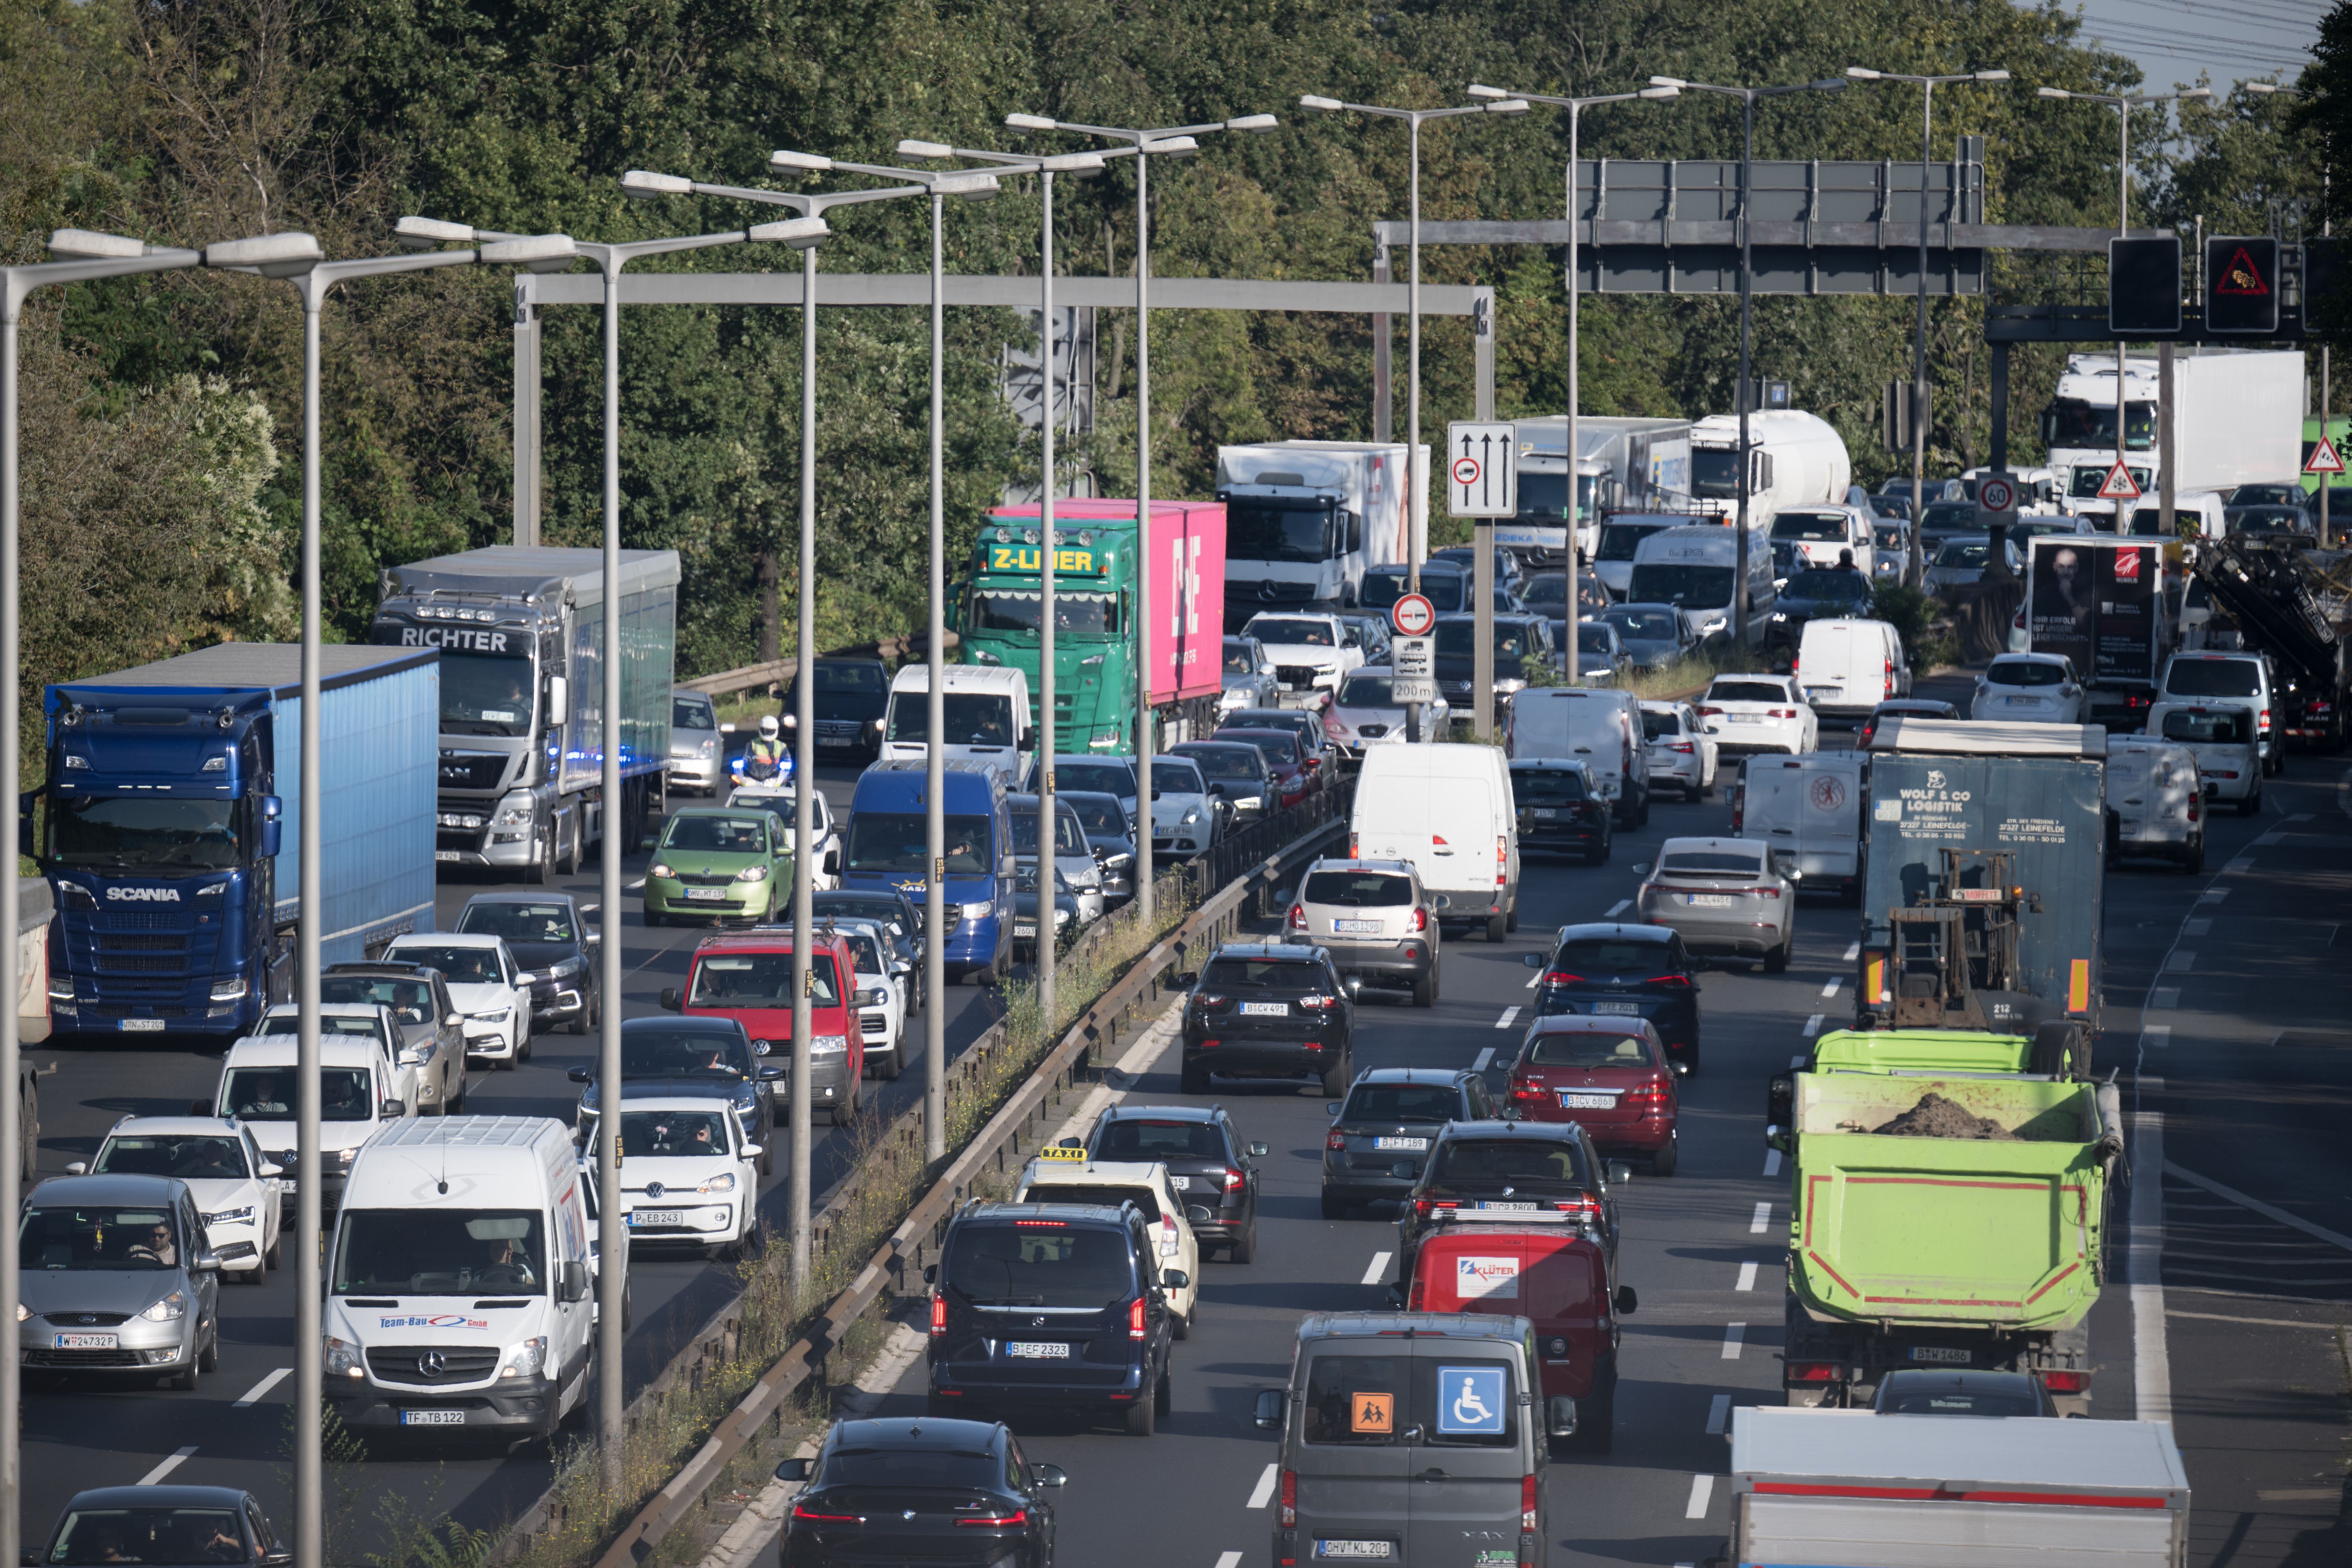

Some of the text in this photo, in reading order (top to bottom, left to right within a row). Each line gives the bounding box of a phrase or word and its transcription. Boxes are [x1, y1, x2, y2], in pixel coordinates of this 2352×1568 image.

[1988, 489, 2006, 503] 60
[995, 549, 1092, 571] Z-LIER
[2305, 607, 2333, 641] FASSI
[402, 628, 507, 651] RICHTER
[1397, 685, 1430, 696] 200 m
[1900, 789, 1971, 801] WOLF & CO
[1907, 801, 1963, 813] LOGISTIK
[2021, 824, 2065, 833] LEINEFELDE
[106, 887, 180, 901] SCANIA
[1966, 891, 1998, 899] MOFFETT
[1994, 1004, 2010, 1013] 212
[1569, 1096, 1574, 1104] B
[1382, 1138, 1388, 1146] B
[1408, 1139, 1423, 1147] 189
[1048, 1150, 1079, 1158] TAXI
[636, 1213, 678, 1222] P EB 243
[1474, 1265, 1515, 1282] KLÜTER
[380, 1317, 488, 1328] Team-Bau GmbH
[63, 1335, 71, 1346] W
[1013, 1344, 1067, 1355] B EF 2323
[1918, 1349, 1967, 1361] B W 1486
[407, 1413, 462, 1423] TF TB 122
[1462, 1531, 1505, 1541] MAN
[1327, 1542, 1387, 1554] OHV KL 201
